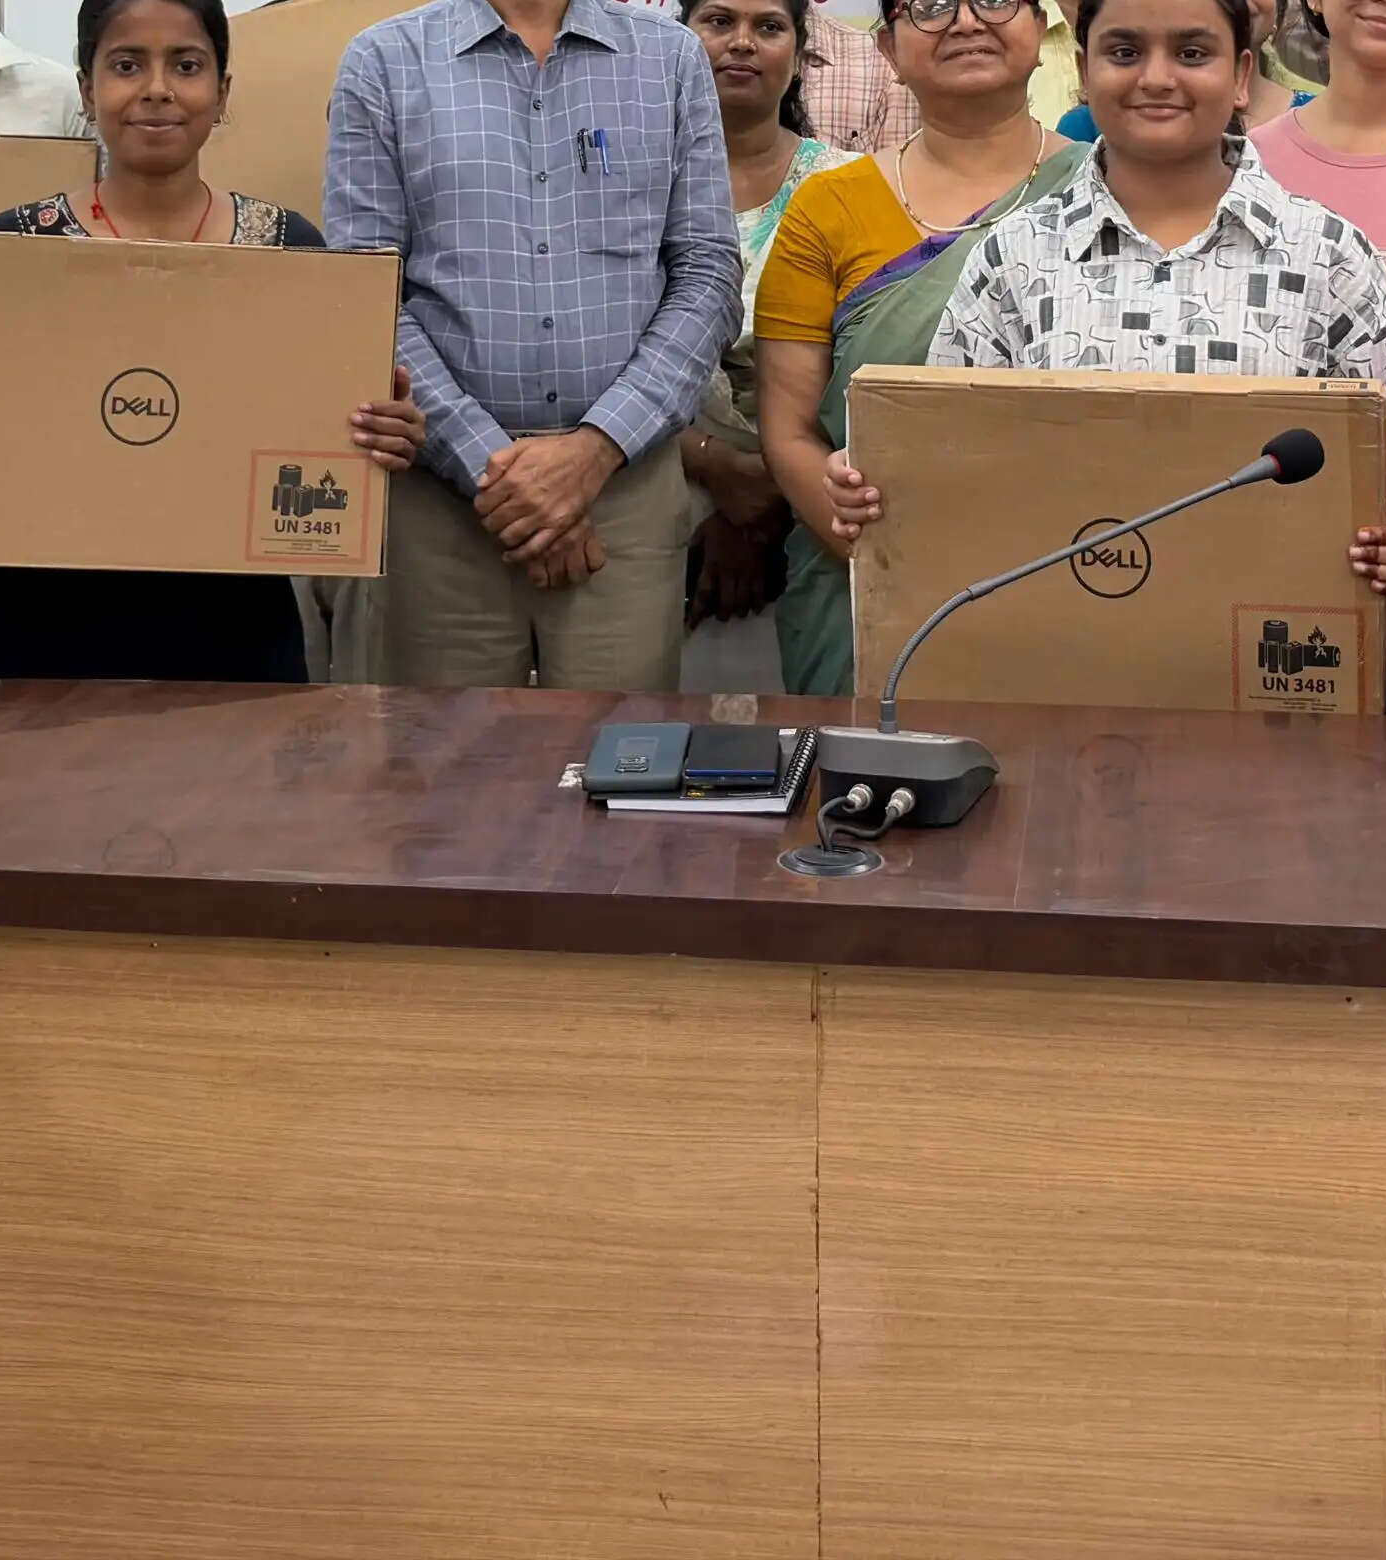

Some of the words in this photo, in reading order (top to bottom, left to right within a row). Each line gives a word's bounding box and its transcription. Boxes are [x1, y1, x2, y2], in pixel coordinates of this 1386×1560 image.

[111, 395, 172, 418] DELL
[274, 519, 299, 534] UN
[302, 520, 342, 535] 3481
[1081, 546, 1144, 570] DELL
[1262, 676, 1289, 692] UN
[1293, 678, 1335, 694] 3481
